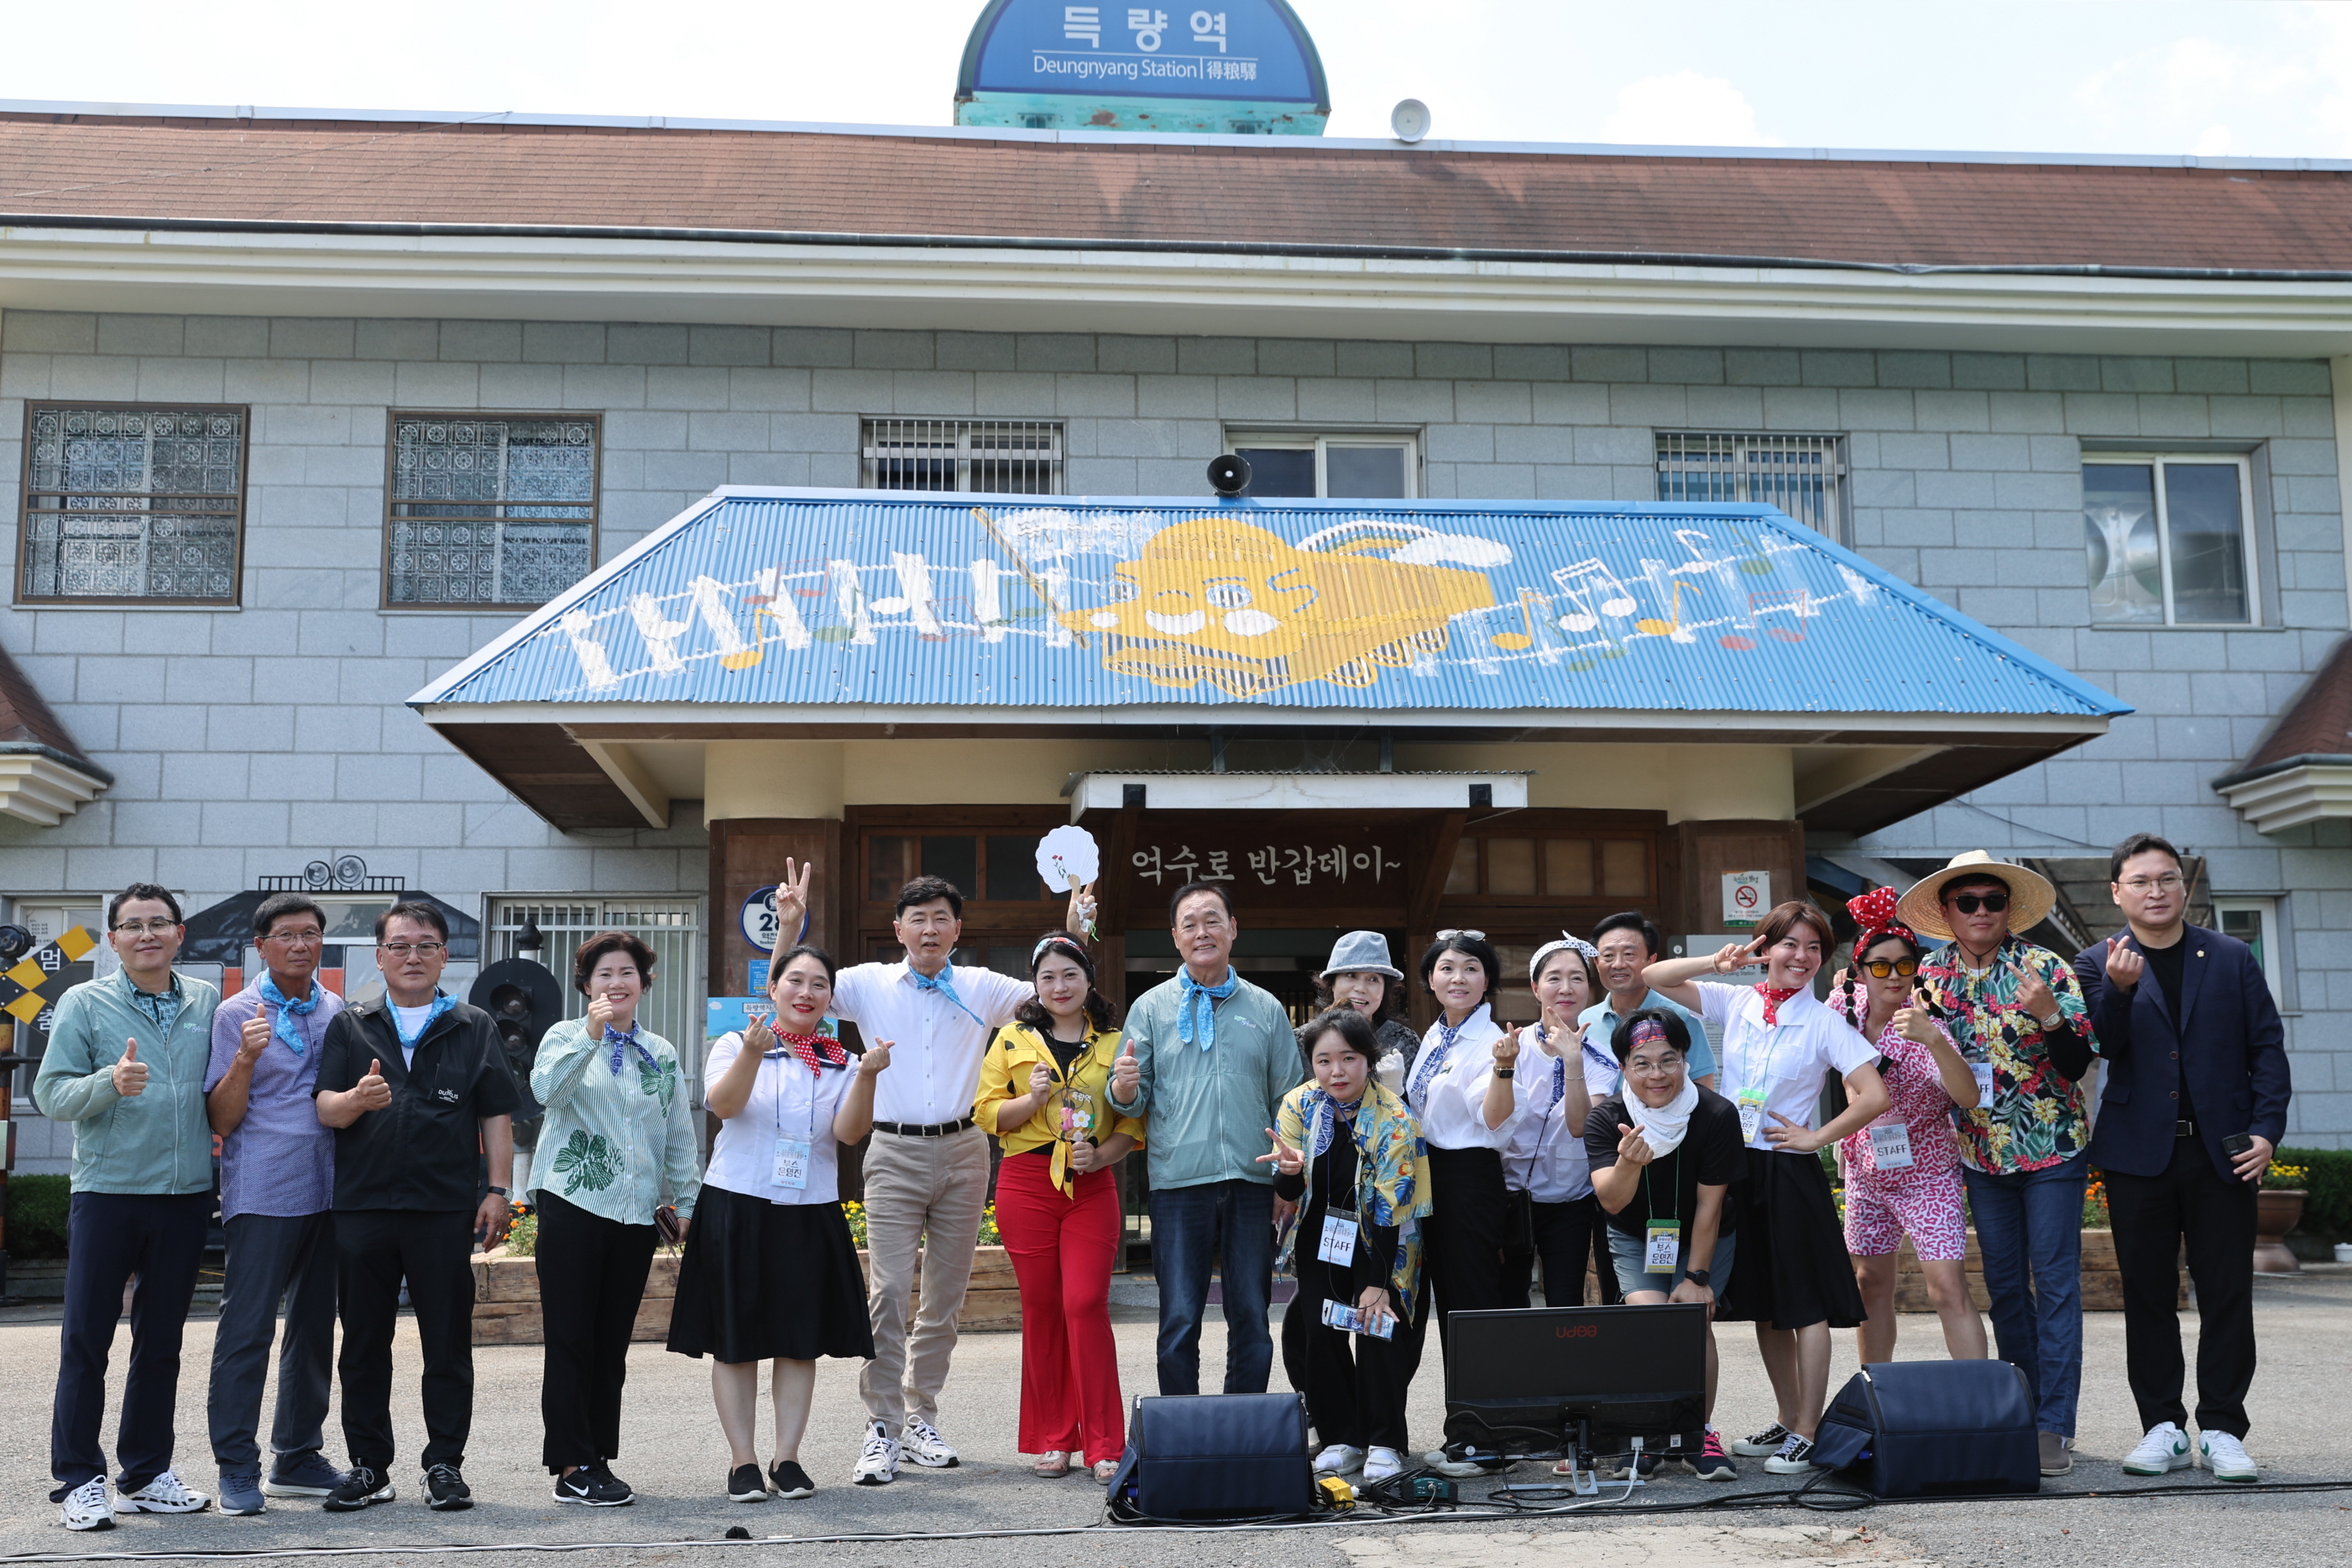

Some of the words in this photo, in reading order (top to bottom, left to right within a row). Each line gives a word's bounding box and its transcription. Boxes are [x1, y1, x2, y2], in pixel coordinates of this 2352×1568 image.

[1064, 6, 1226, 53] 득량역
[1034, 55, 1138, 80] Deungnyang
[1142, 59, 1197, 78] Station
[1132, 845, 1236, 886] 억수로
[41, 947, 61, 971] 멈
[1072, 1091, 1092, 1104] 득량역
[1740, 1112, 1754, 1123] 부스
[1740, 1121, 1755, 1134] 영진
[1877, 1144, 1907, 1157] STAFF
[782, 1159, 799, 1169] 부스
[778, 1167, 802, 1178] 운영진
[1323, 1236, 1352, 1252] STAFF
[1657, 1243, 1671, 1253] 부스
[1652, 1253, 1674, 1265] 운영진
